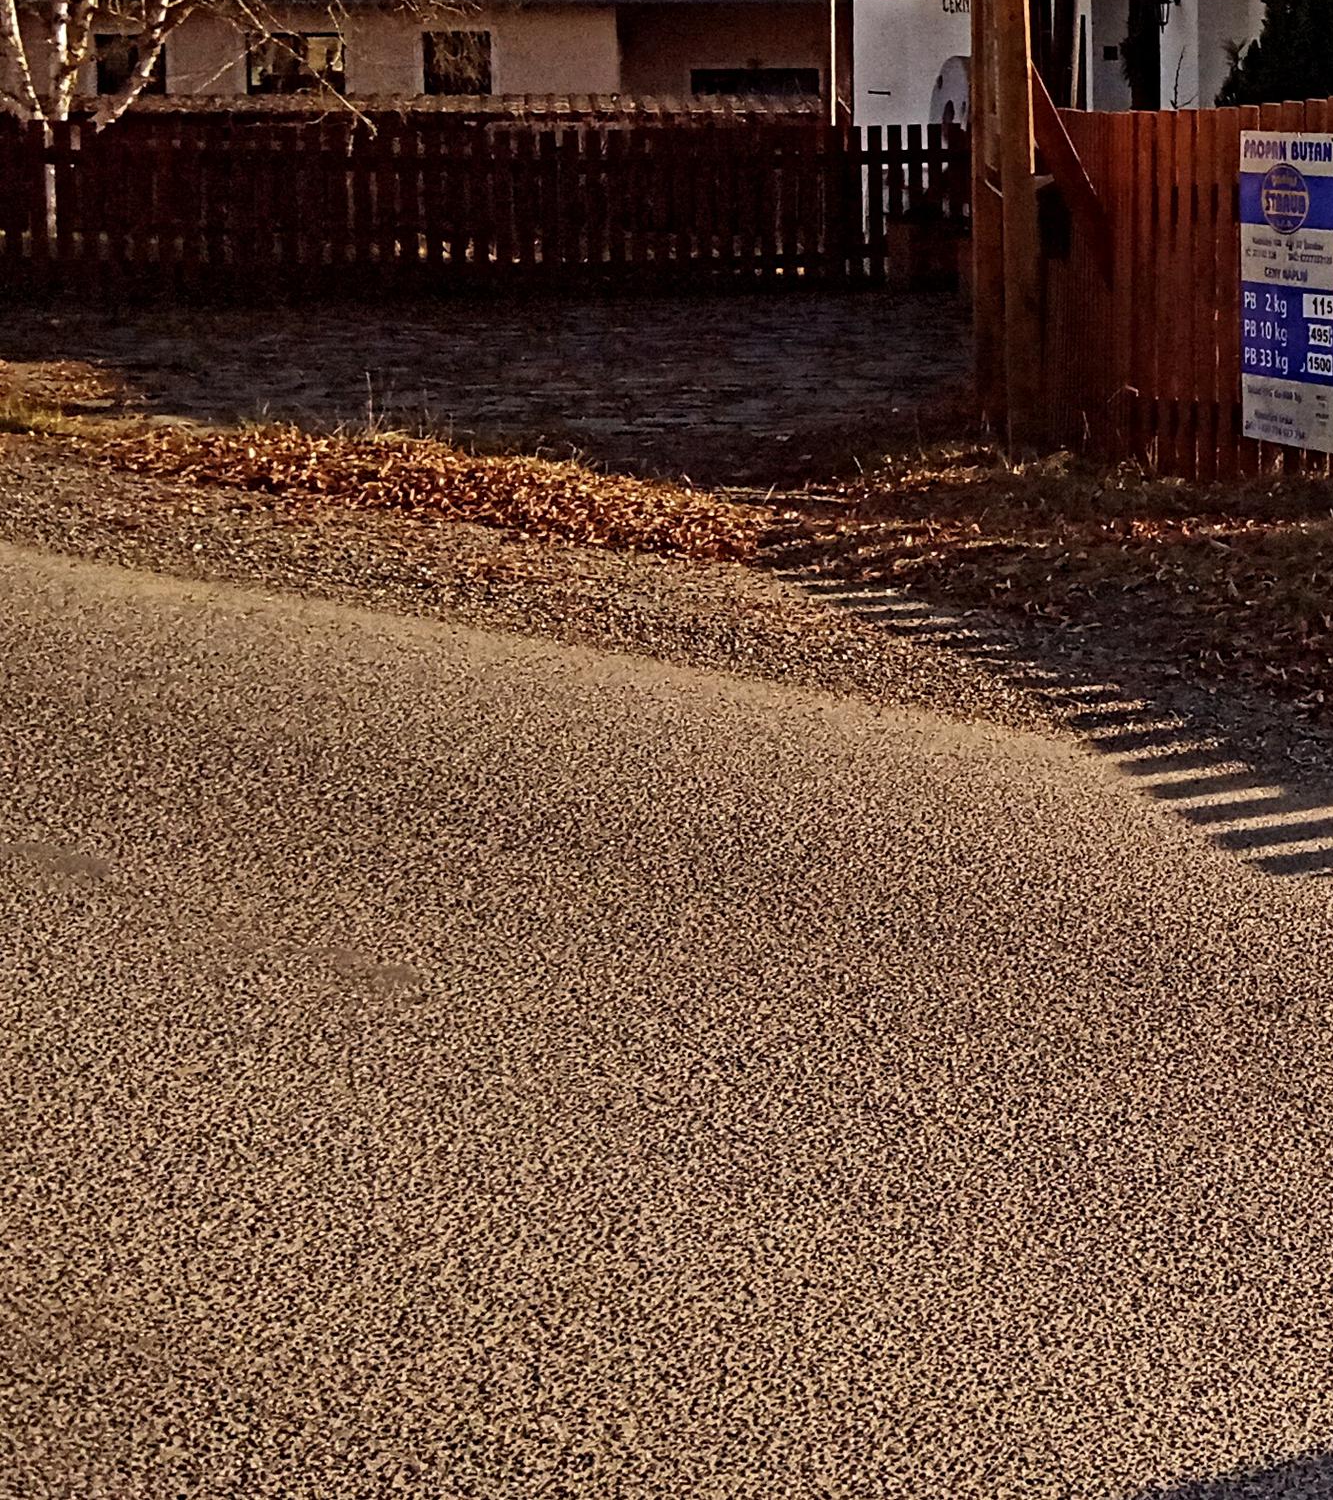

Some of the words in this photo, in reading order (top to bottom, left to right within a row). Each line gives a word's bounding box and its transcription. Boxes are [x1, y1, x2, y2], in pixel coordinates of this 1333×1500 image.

[1243, 138, 1287, 162] PROPAN
[1291, 140, 1333, 163] BUTAN
[1244, 291, 1257, 309] PB
[1265, 293, 1272, 312] 2
[1274, 294, 1287, 318] kg
[1312, 297, 1333, 316] 115
[1244, 319, 1257, 338] PB
[1260, 321, 1272, 340] 10
[1274, 322, 1288, 347] kg
[1244, 347, 1257, 366] PB
[1260, 348, 1272, 367] 33
[1275, 350, 1289, 375] kg
[1308, 355, 1331, 373] 1500
